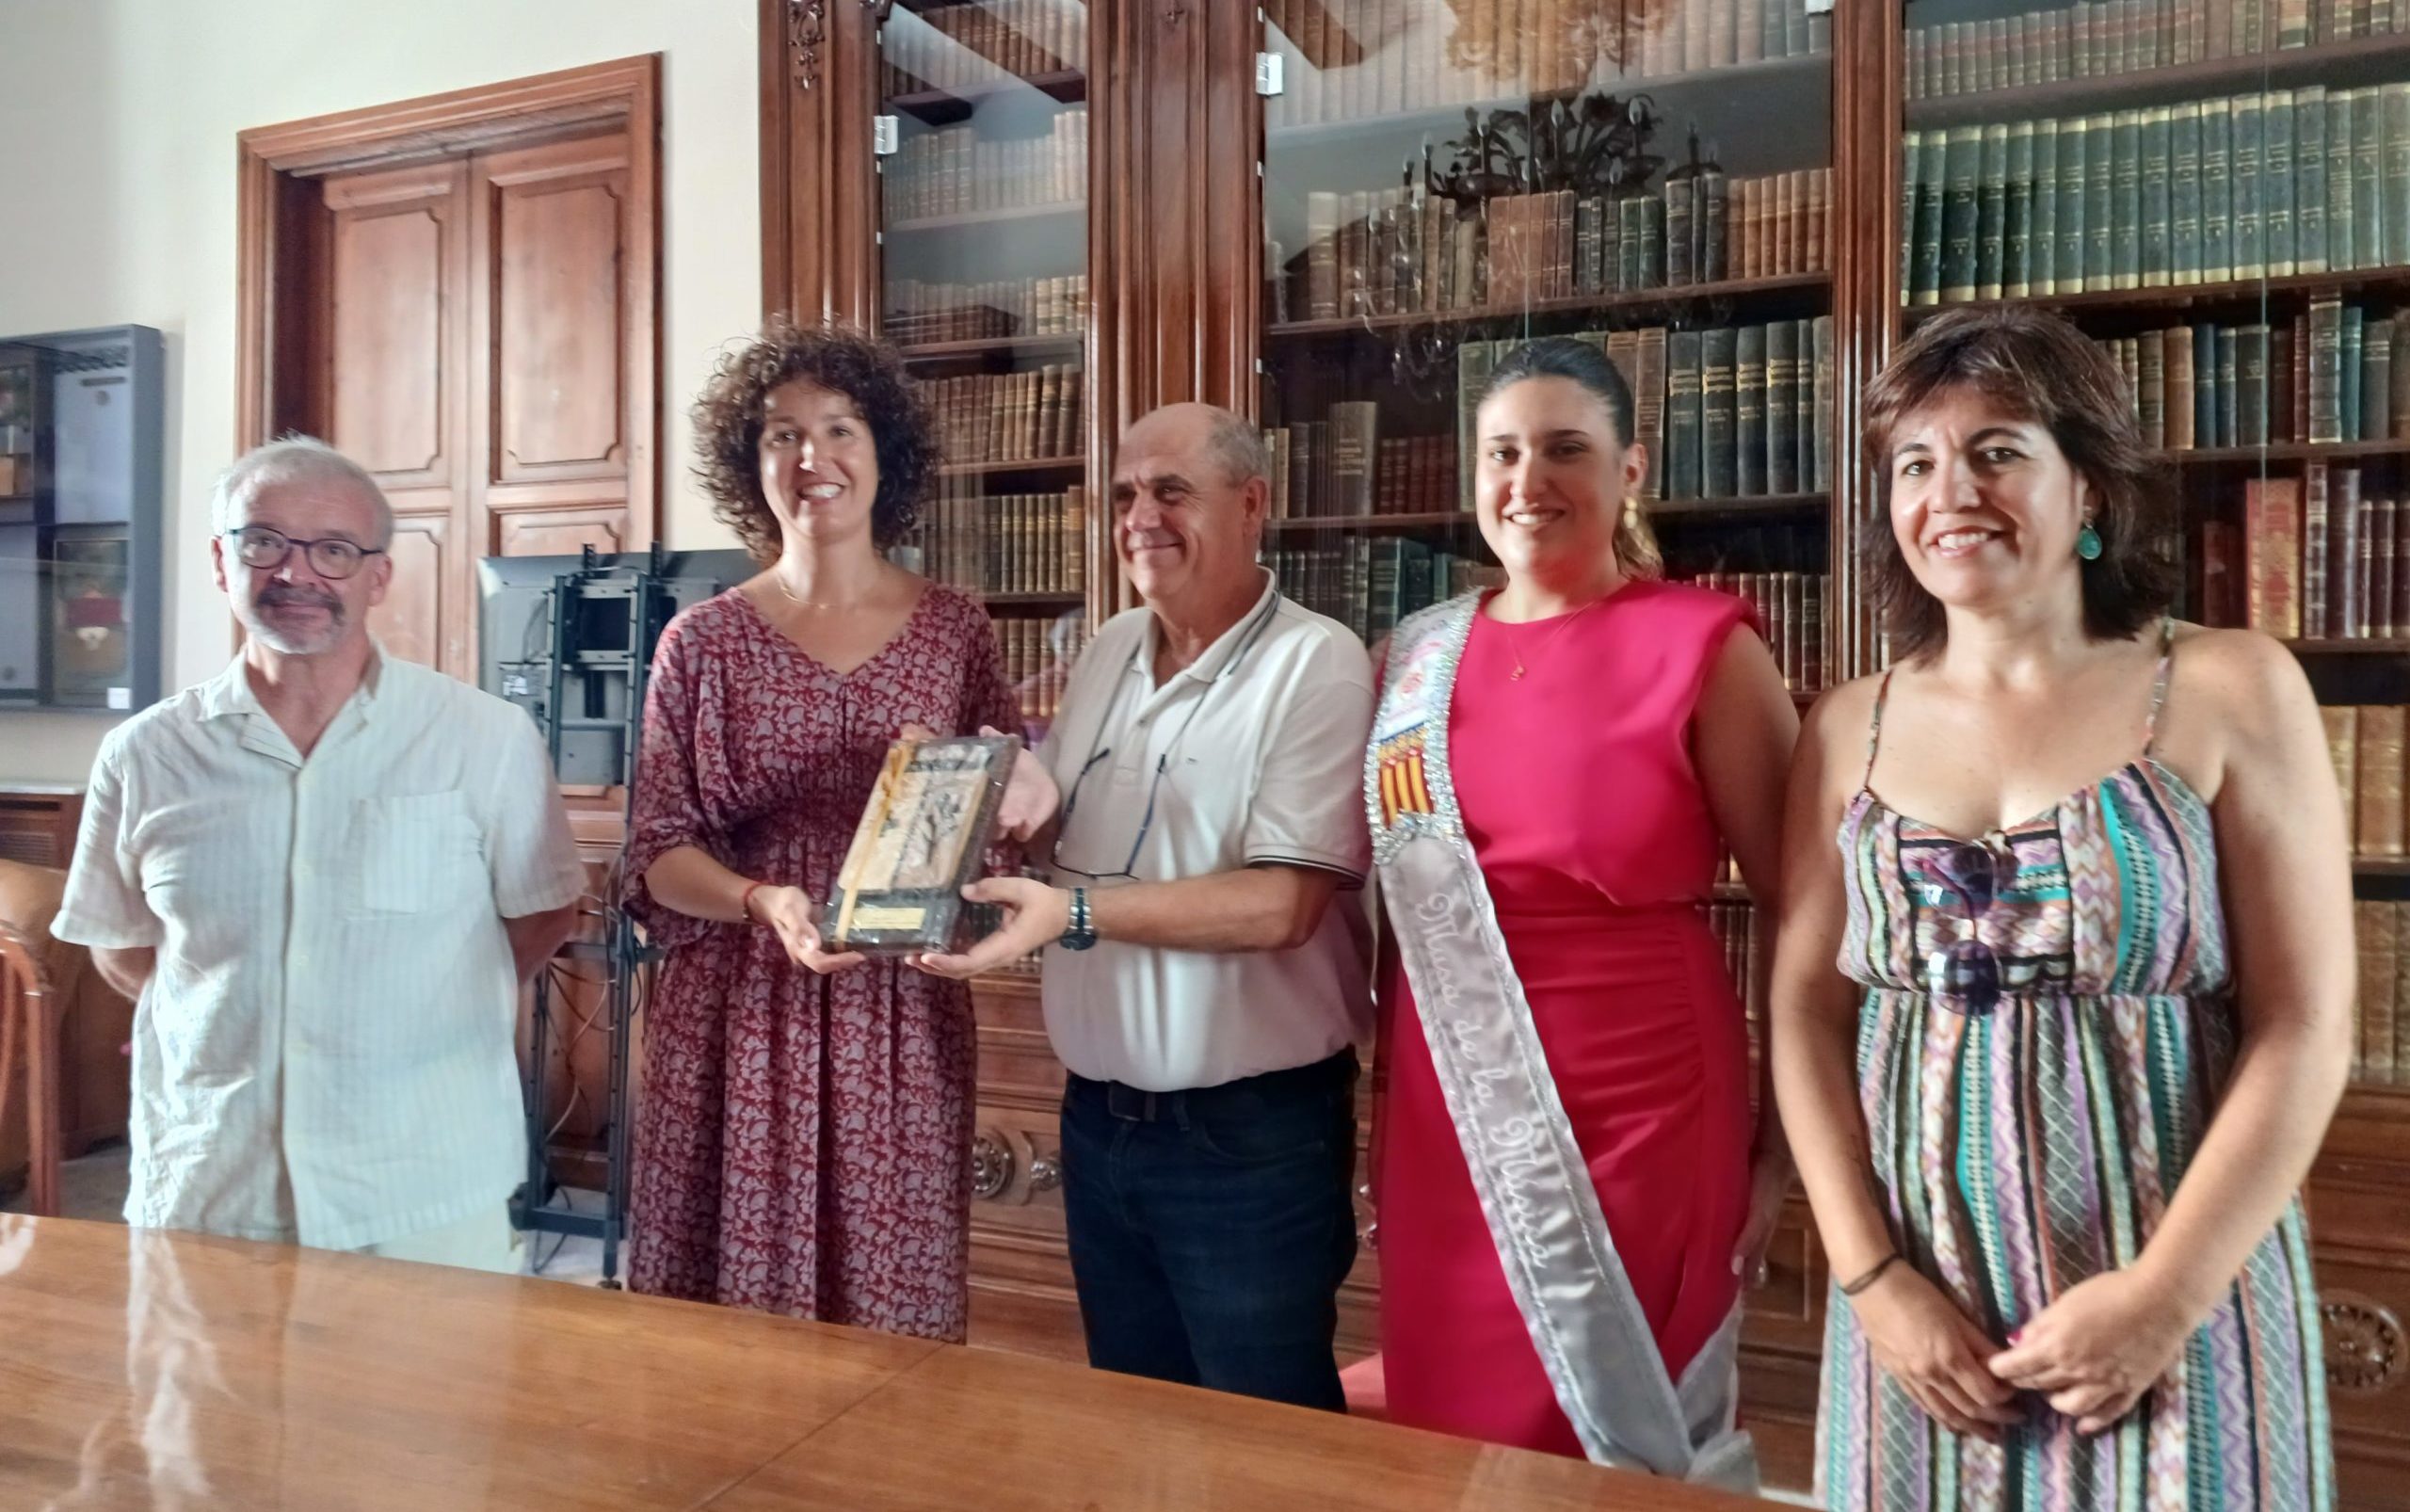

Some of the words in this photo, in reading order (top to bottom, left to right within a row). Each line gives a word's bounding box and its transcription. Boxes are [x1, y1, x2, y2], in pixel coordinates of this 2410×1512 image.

[1416, 893, 1461, 1008] Musa
[1453, 1020, 1484, 1062] de
[1469, 1068, 1510, 1108] la
